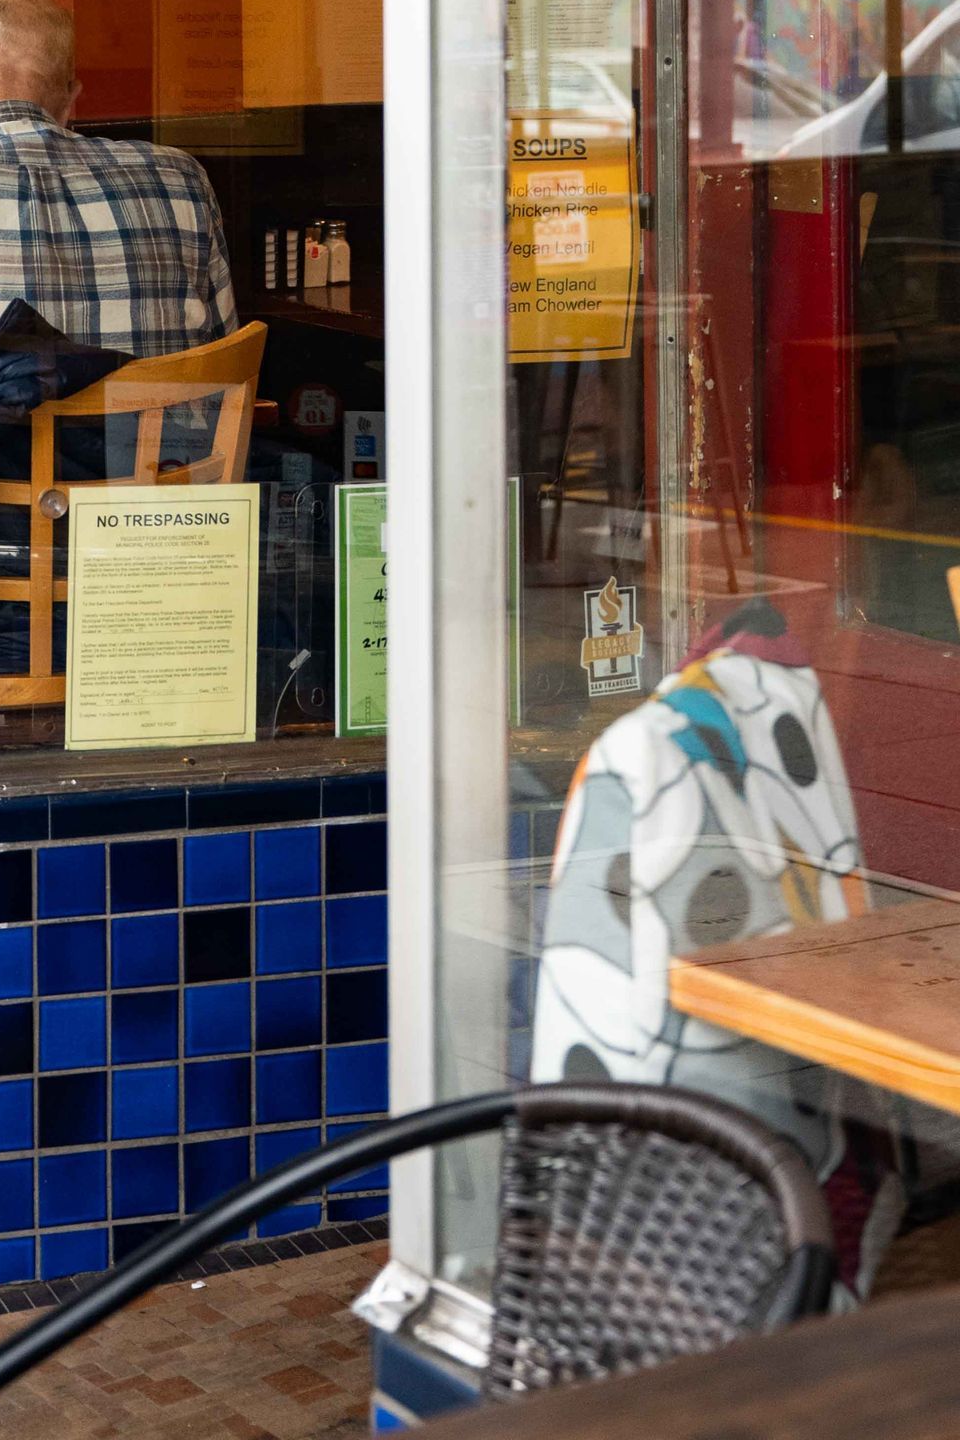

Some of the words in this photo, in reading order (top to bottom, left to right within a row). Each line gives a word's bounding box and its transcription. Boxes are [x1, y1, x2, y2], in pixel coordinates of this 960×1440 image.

[513, 138, 586, 156] SOUPS
[556, 182, 608, 197] Noodle
[566, 202, 598, 216] Rice
[536, 277, 597, 295] England
[508, 300, 531, 313] am
[536, 298, 602, 313] Chowder
[97, 515, 119, 527] NO
[123, 512, 230, 527] TRESPASSING
[591, 635, 631, 650] LEGACY
